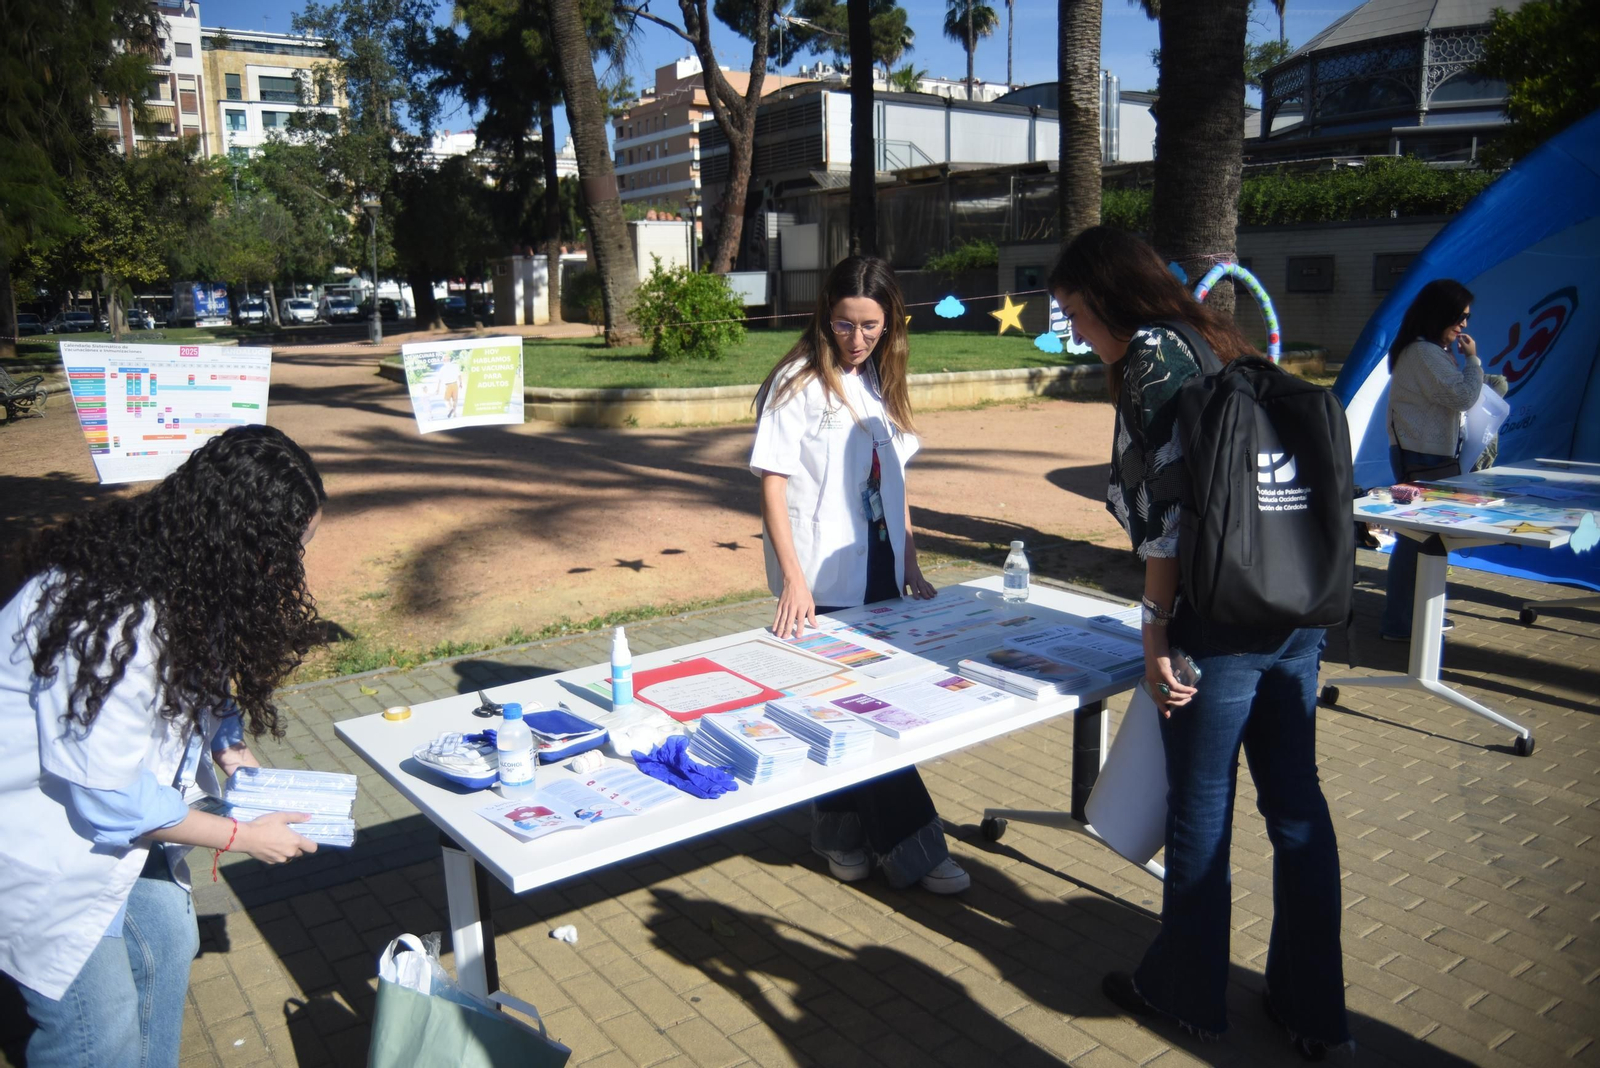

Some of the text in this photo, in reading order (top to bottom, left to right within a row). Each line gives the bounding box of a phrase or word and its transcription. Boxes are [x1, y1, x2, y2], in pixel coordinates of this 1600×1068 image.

[181, 347, 198, 356] 2025
[1278, 495, 1307, 503] Occidental
[1283, 503, 1308, 511] Córdoba
